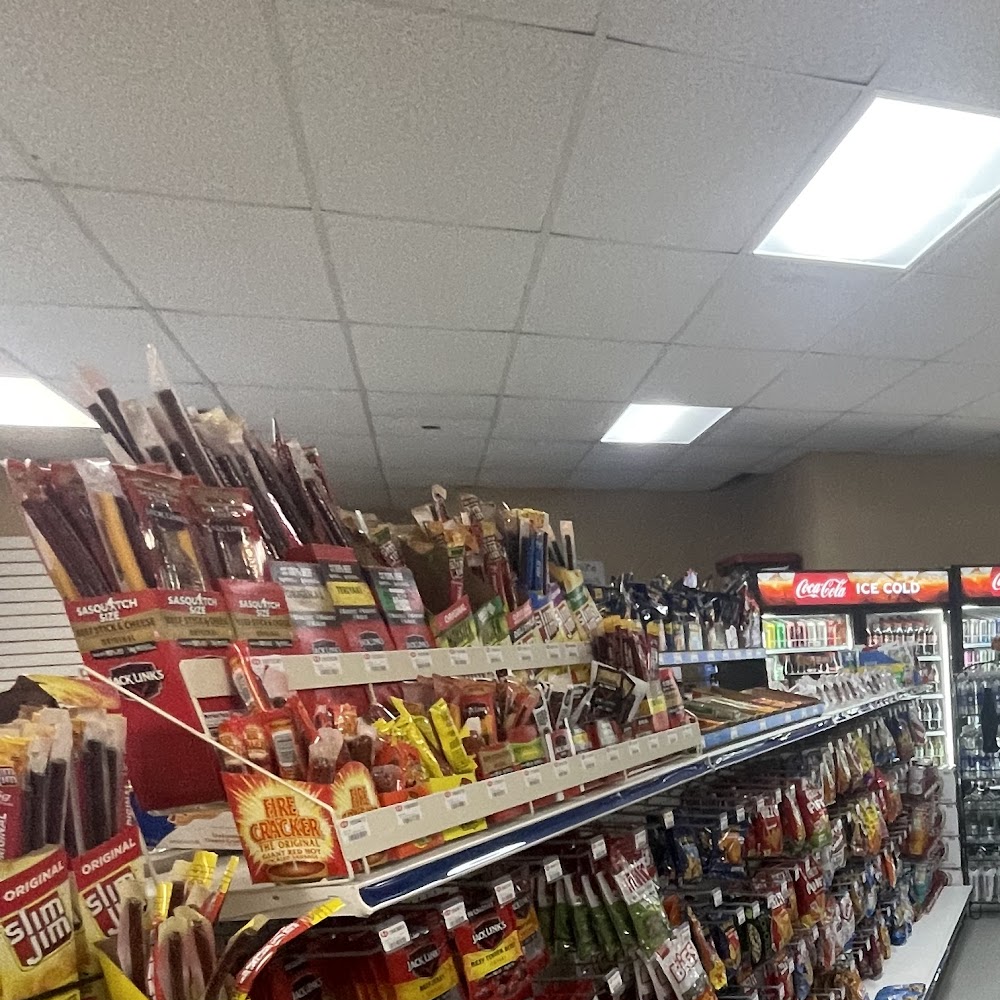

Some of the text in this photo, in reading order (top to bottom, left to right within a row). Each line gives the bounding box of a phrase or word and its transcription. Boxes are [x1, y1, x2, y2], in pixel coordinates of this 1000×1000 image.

[796, 577, 848, 600] Coca-Cola
[856, 581, 921, 596] ICE COLD
[76, 597, 138, 617] SASQUATCH
[99, 609, 120, 622] SIZE
[189, 604, 206, 616] SIZE
[263, 796, 299, 818] FIRE
[250, 817, 323, 843] CRACKER
[82, 838, 136, 875] ORIGINAL
[258, 838, 322, 853] THE ORIGINAL
[4, 861, 65, 902] ORIGINAL
[5, 898, 65, 945] slim
[27, 916, 72, 966] jim
[472, 929, 488, 945] JACK
